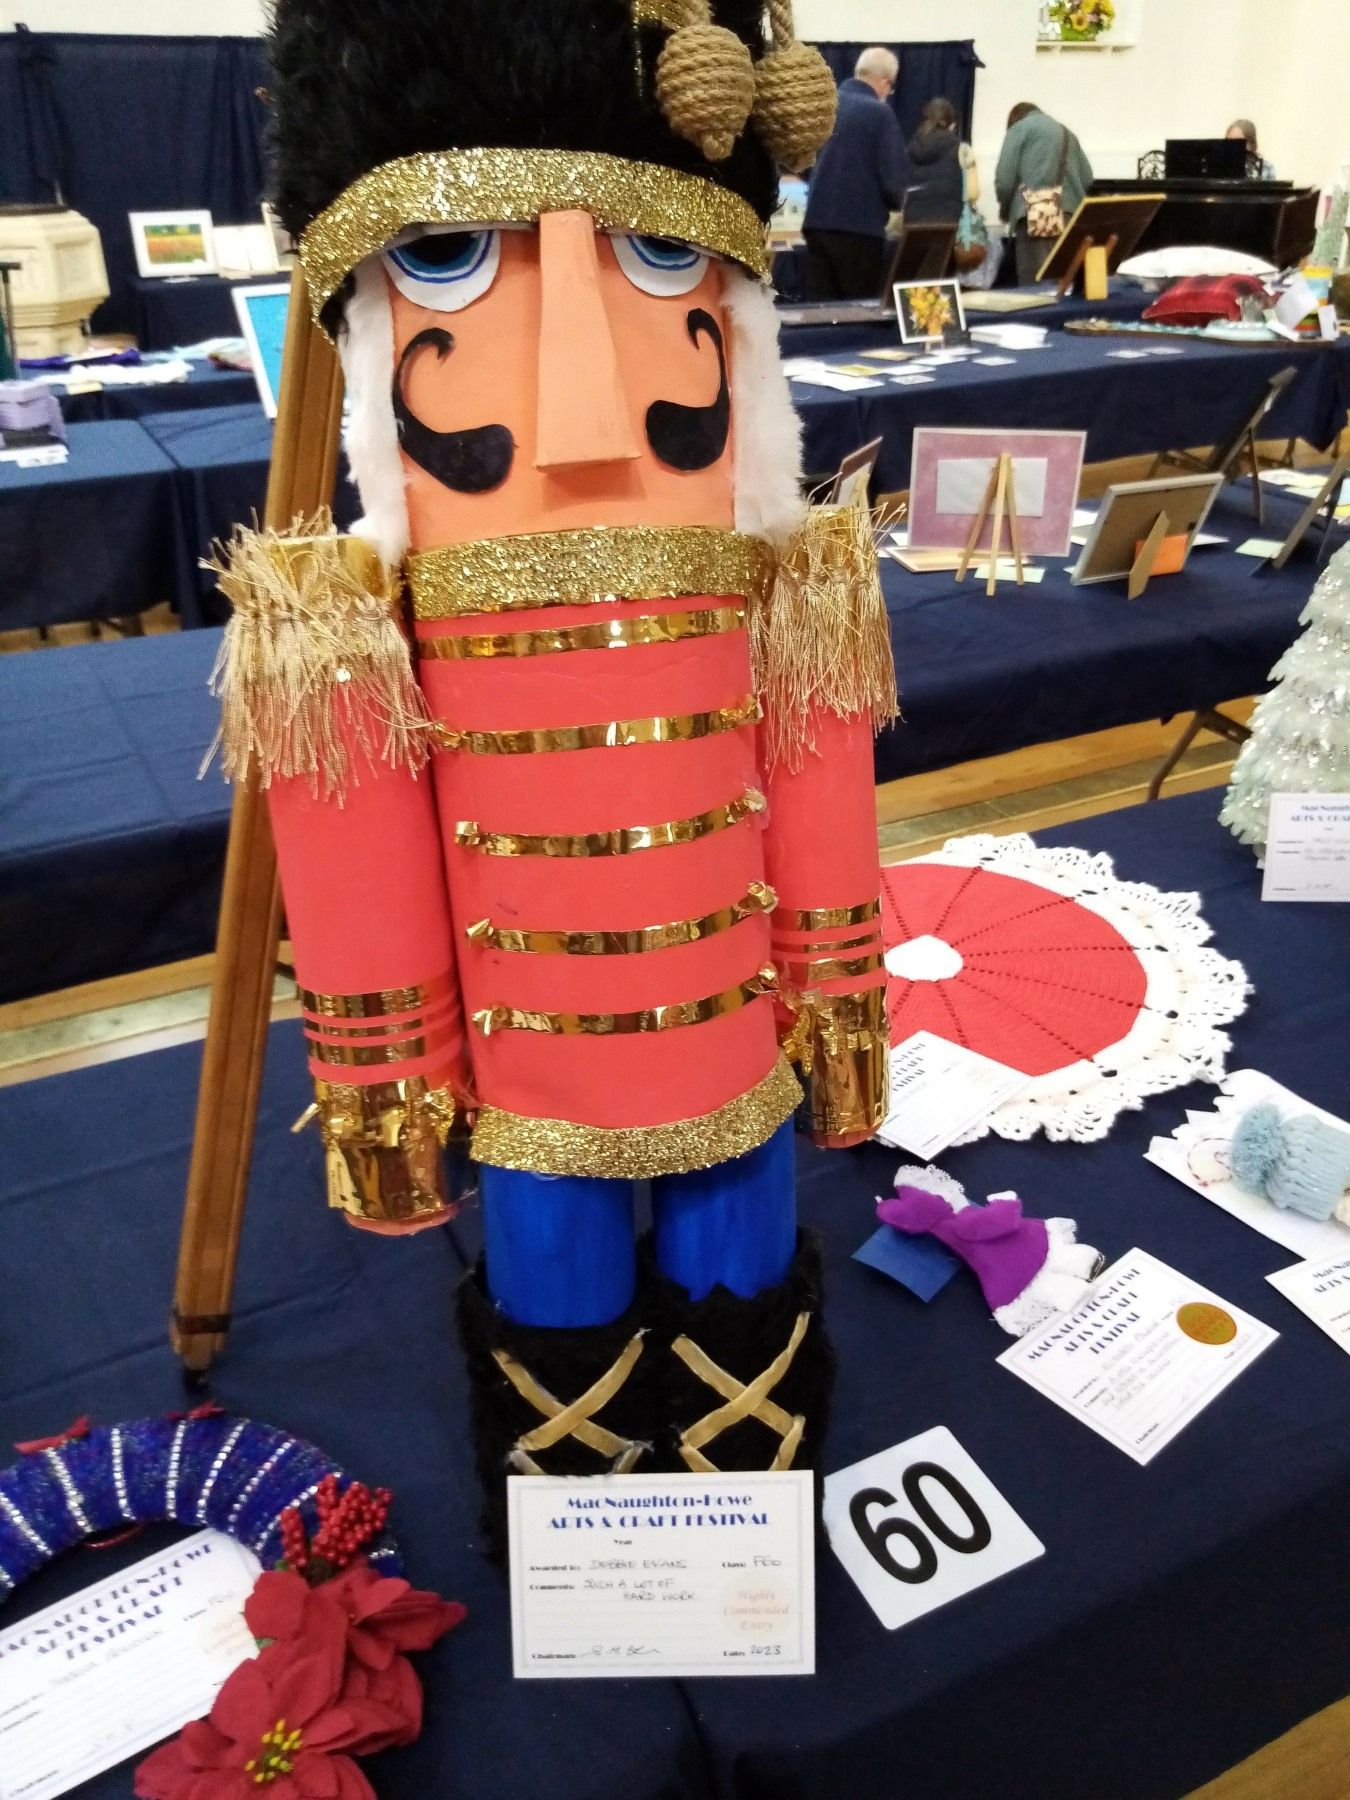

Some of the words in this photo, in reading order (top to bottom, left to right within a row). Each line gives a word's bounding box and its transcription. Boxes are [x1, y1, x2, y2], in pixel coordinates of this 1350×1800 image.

[547, 1515, 594, 1529] ARTS
[618, 1513, 680, 1528] CRAFT
[685, 1511, 772, 1527] FESTIVAL
[848, 1460, 992, 1585] 60
